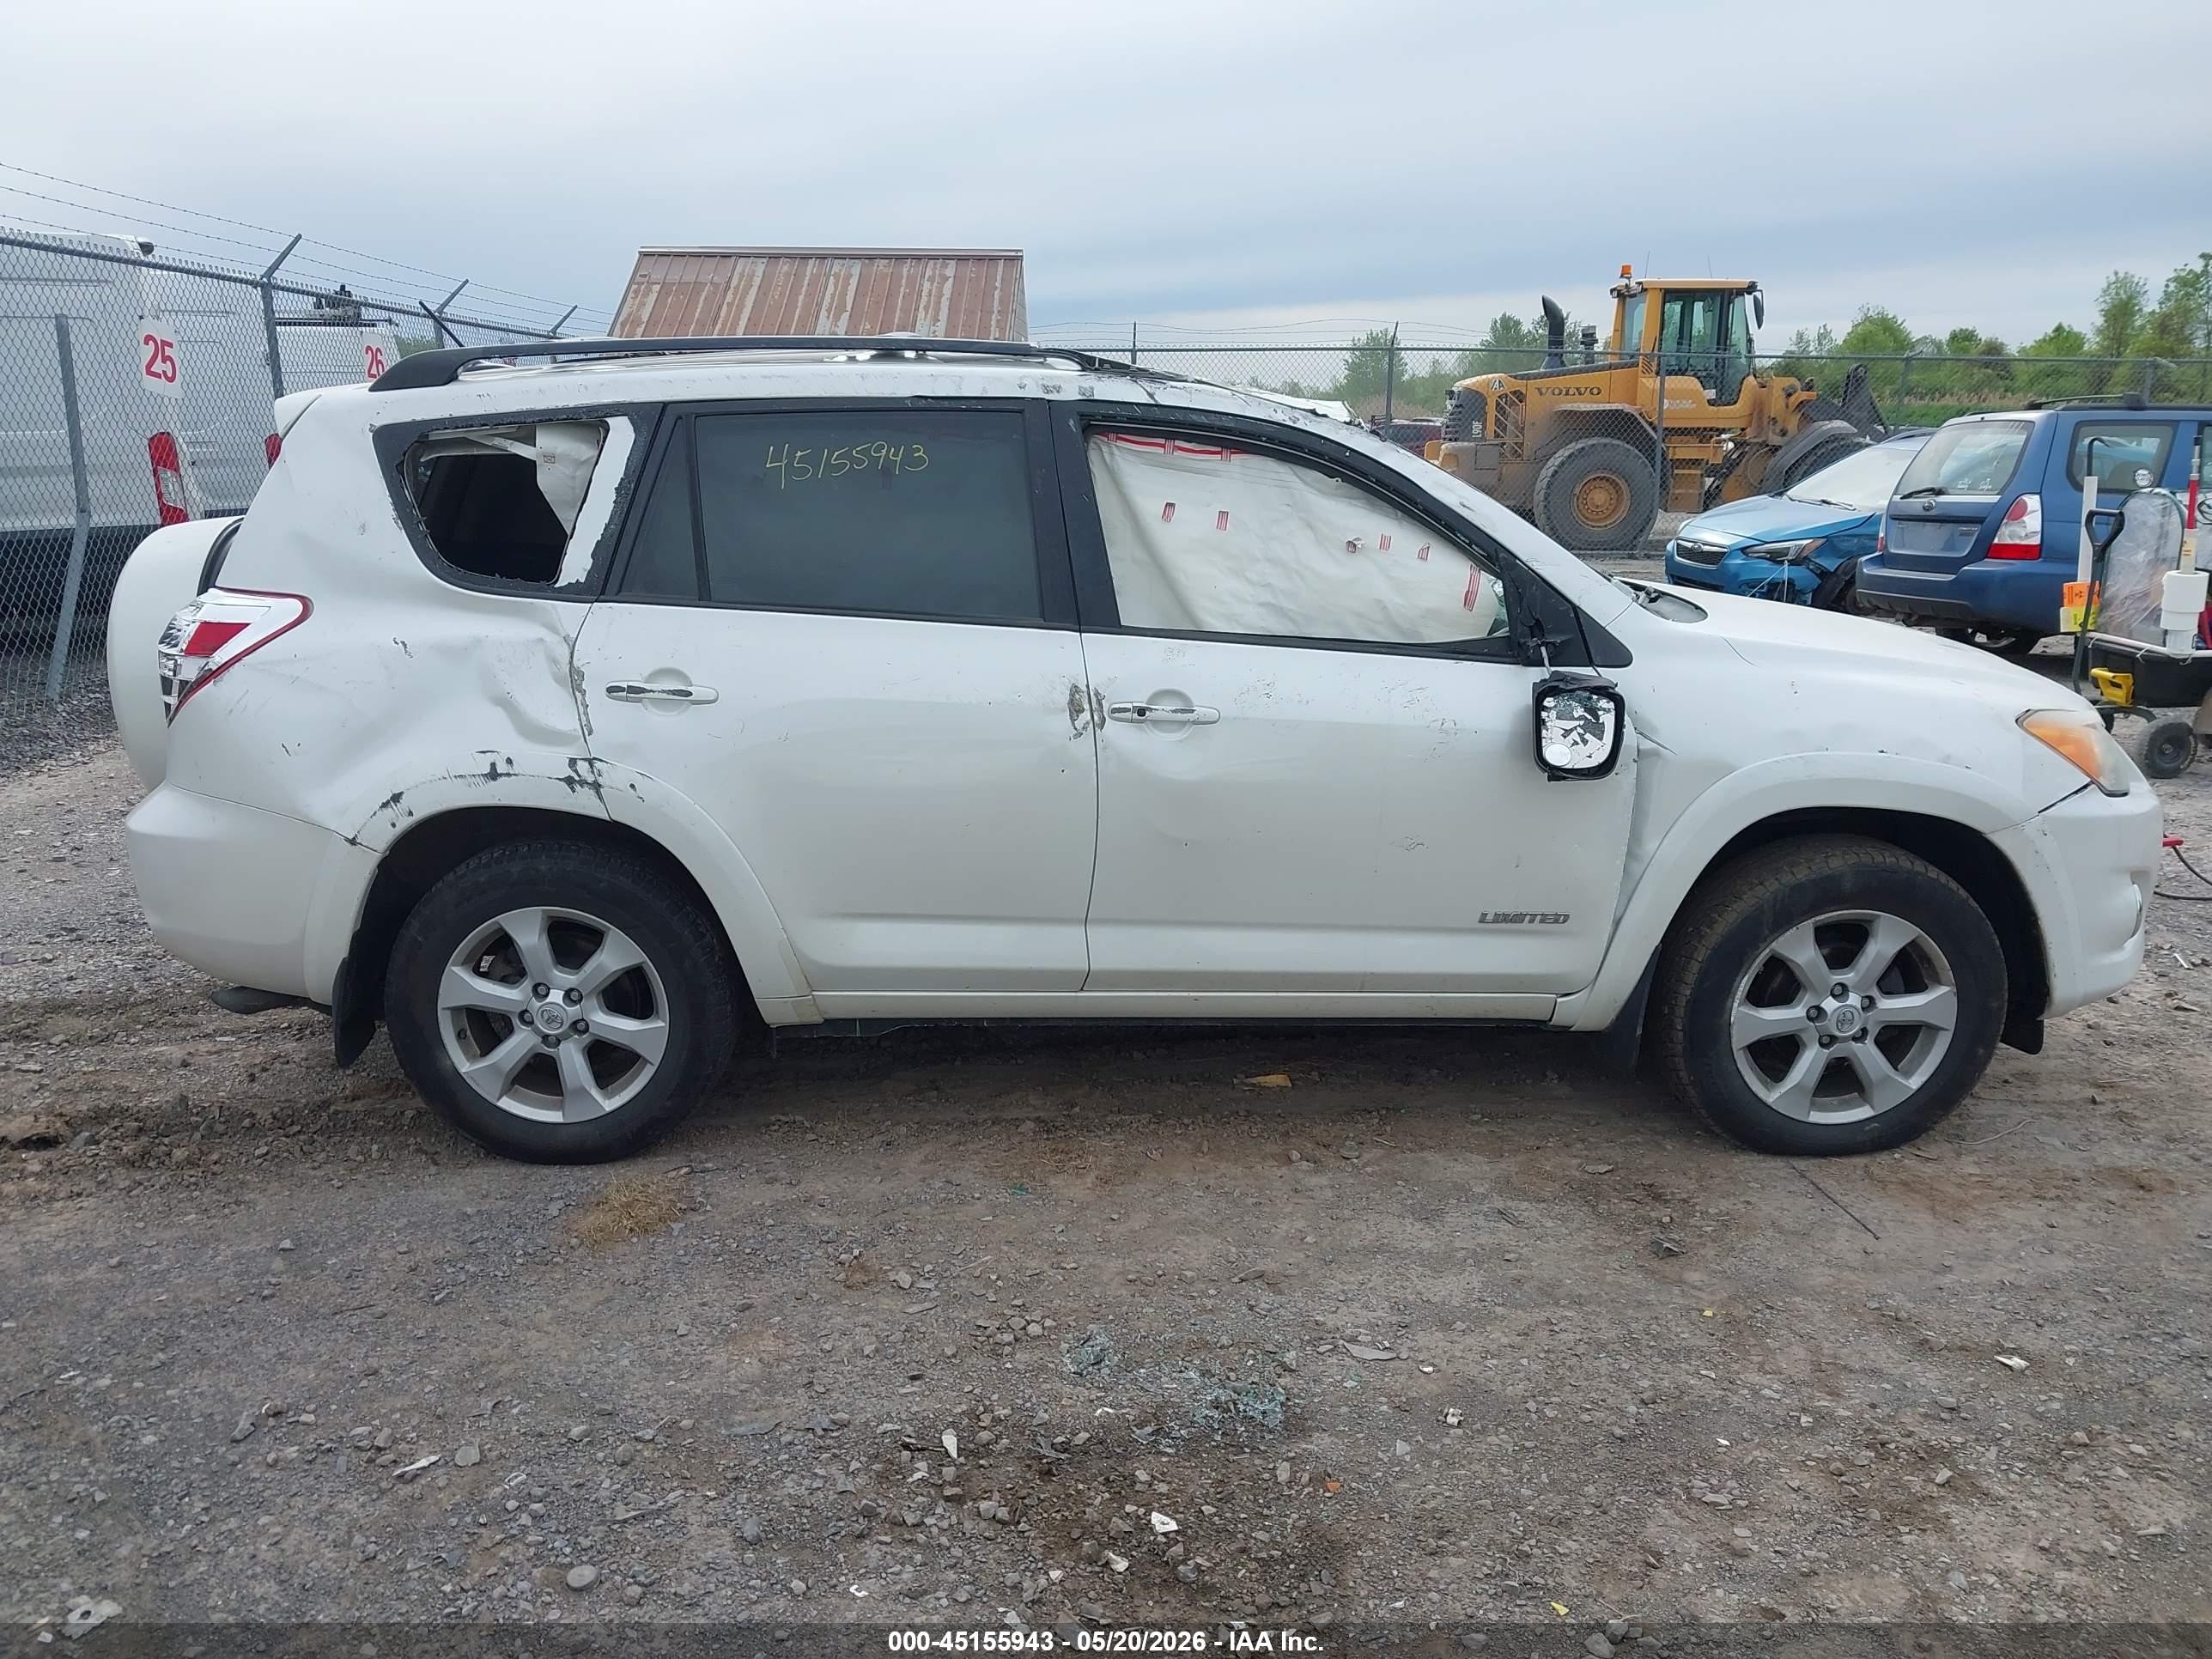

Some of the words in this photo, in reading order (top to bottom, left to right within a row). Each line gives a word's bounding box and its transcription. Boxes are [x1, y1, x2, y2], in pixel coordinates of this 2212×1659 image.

[143, 333, 178, 383] 25
[365, 344, 386, 379] 26
[1534, 386, 1602, 396] VOLVO
[1471, 420, 1483, 438] L90F
[765, 441, 929, 489] 45155943
[1478, 910, 1571, 925] LIMITED
